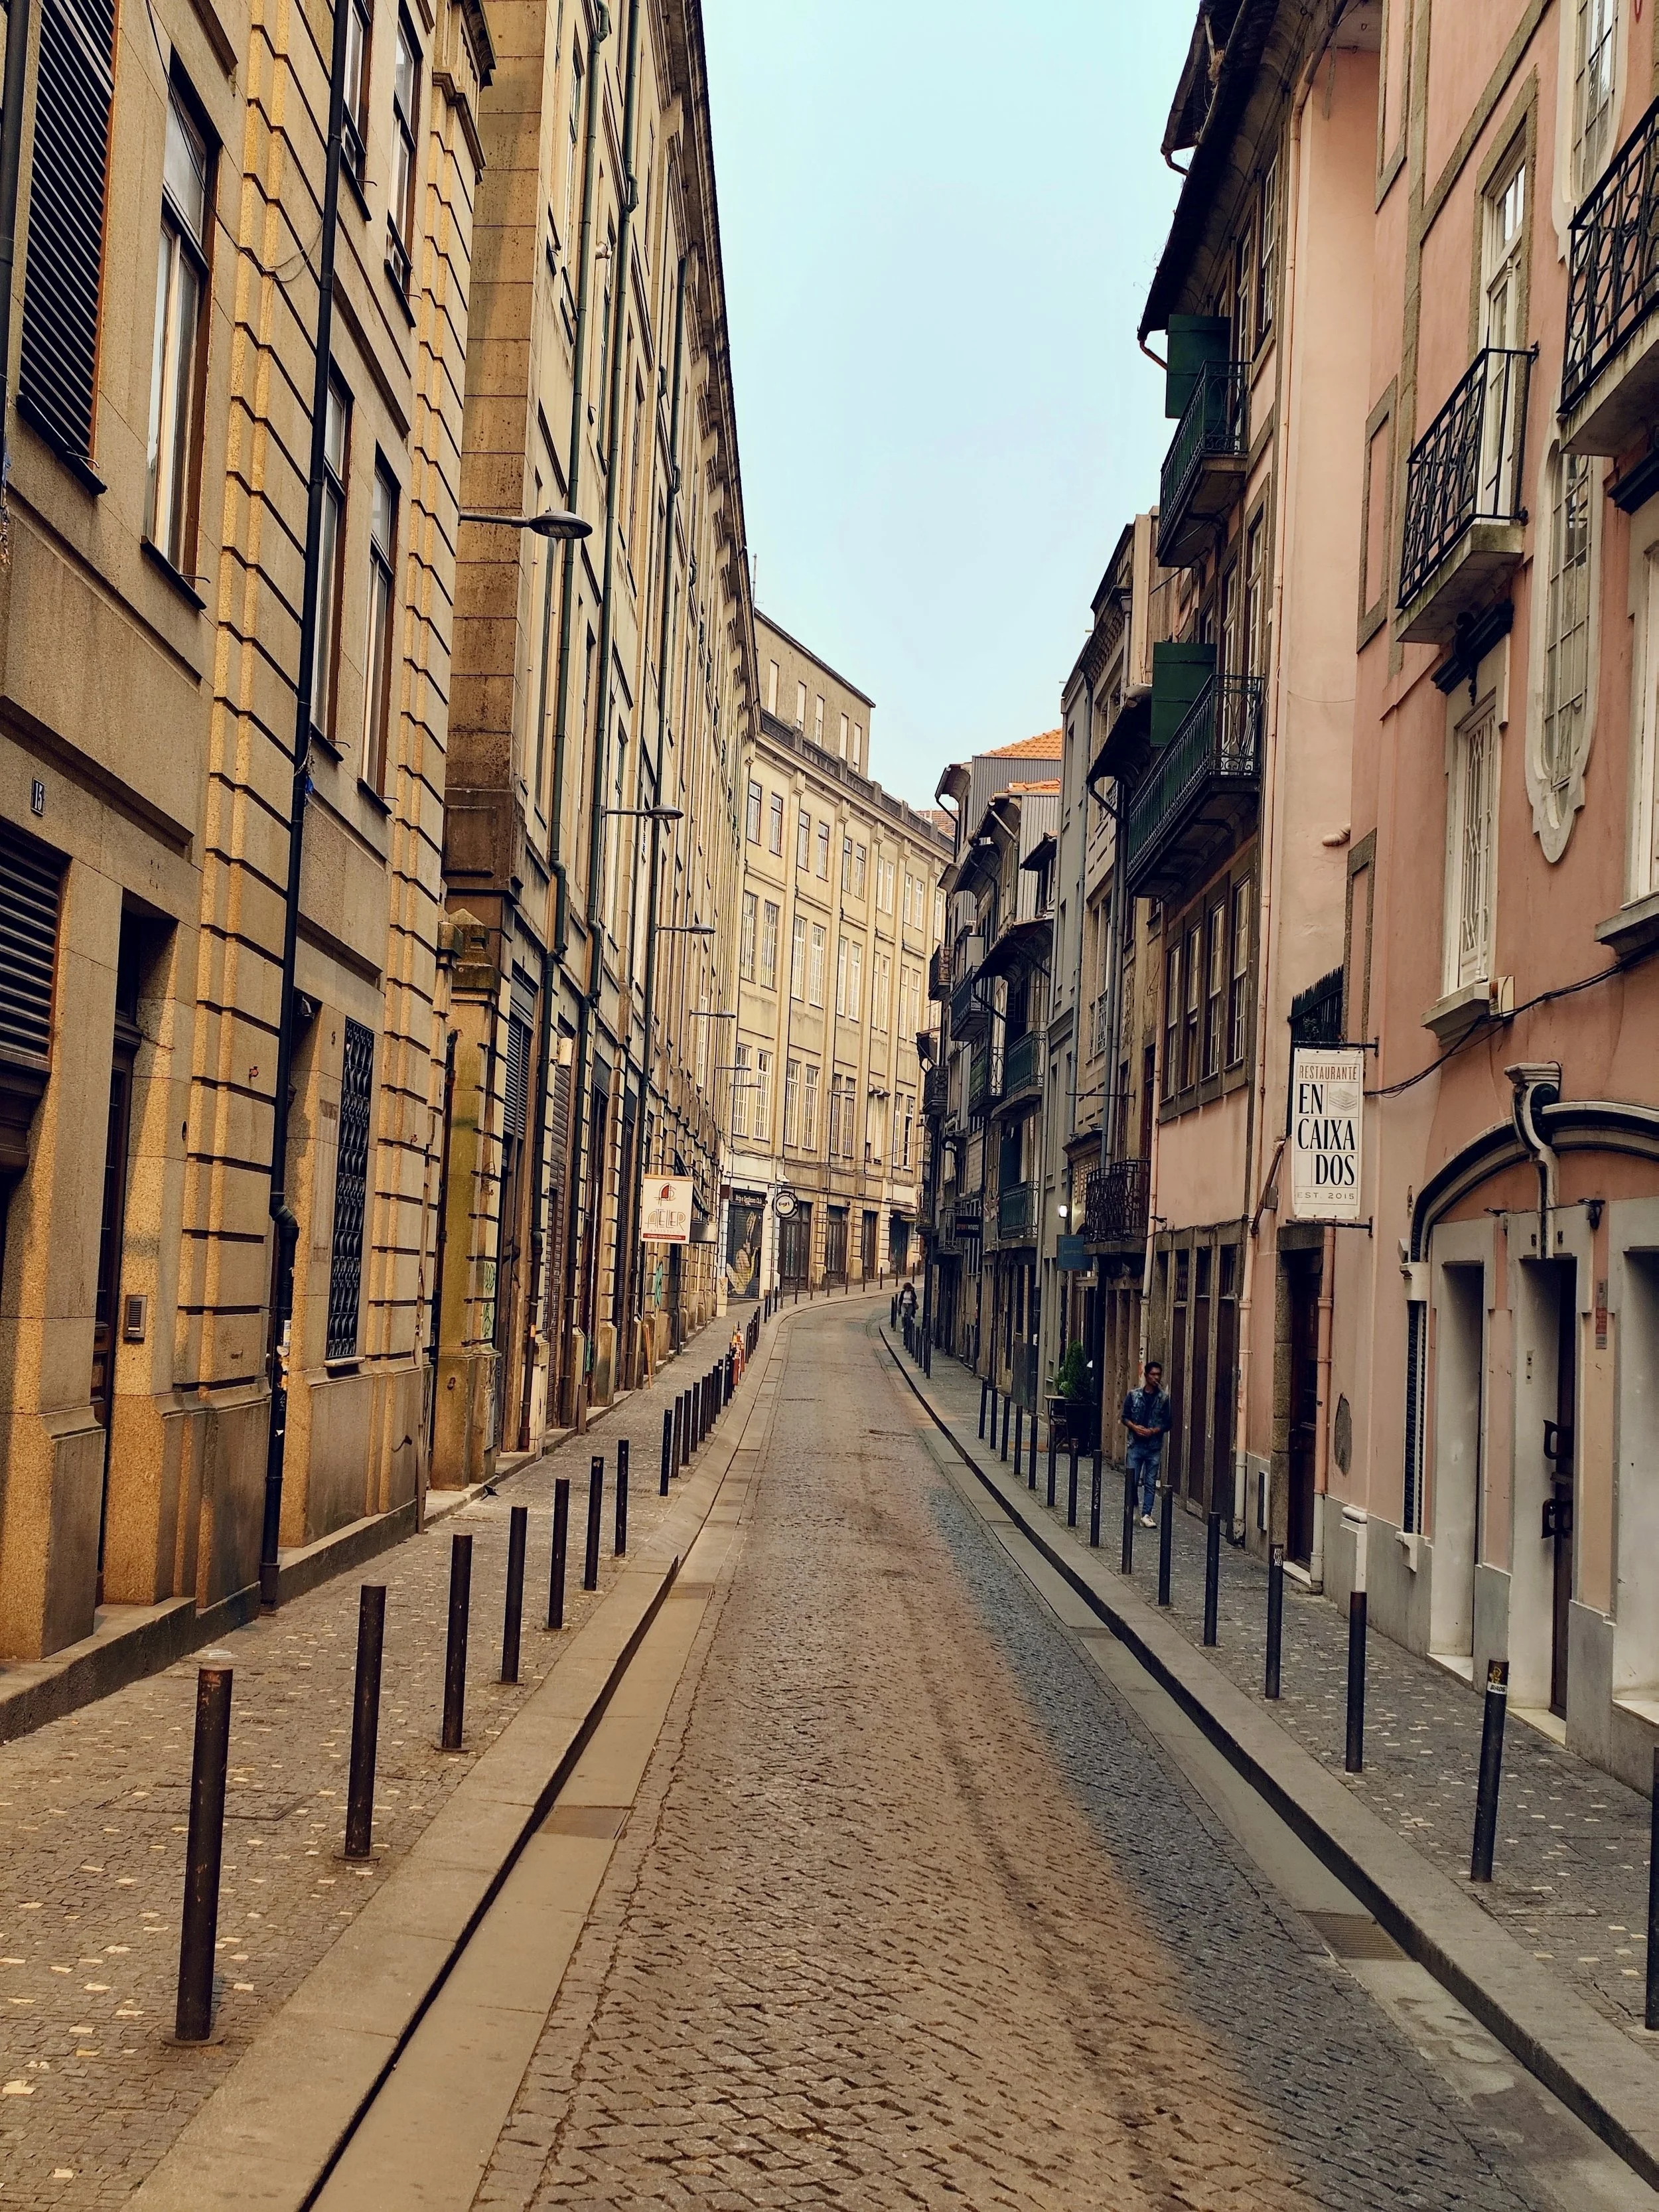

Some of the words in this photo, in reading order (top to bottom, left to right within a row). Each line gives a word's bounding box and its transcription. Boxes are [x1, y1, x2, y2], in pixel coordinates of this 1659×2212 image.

[35, 782, 43, 811] 15
[1299, 1065, 1357, 1080] RESTAURANTE
[1299, 1083, 1323, 1114] EN
[1297, 1118, 1355, 1150] CAIXA
[1315, 1154, 1354, 1186] DOS
[644, 1209, 686, 1231] ATELIER
